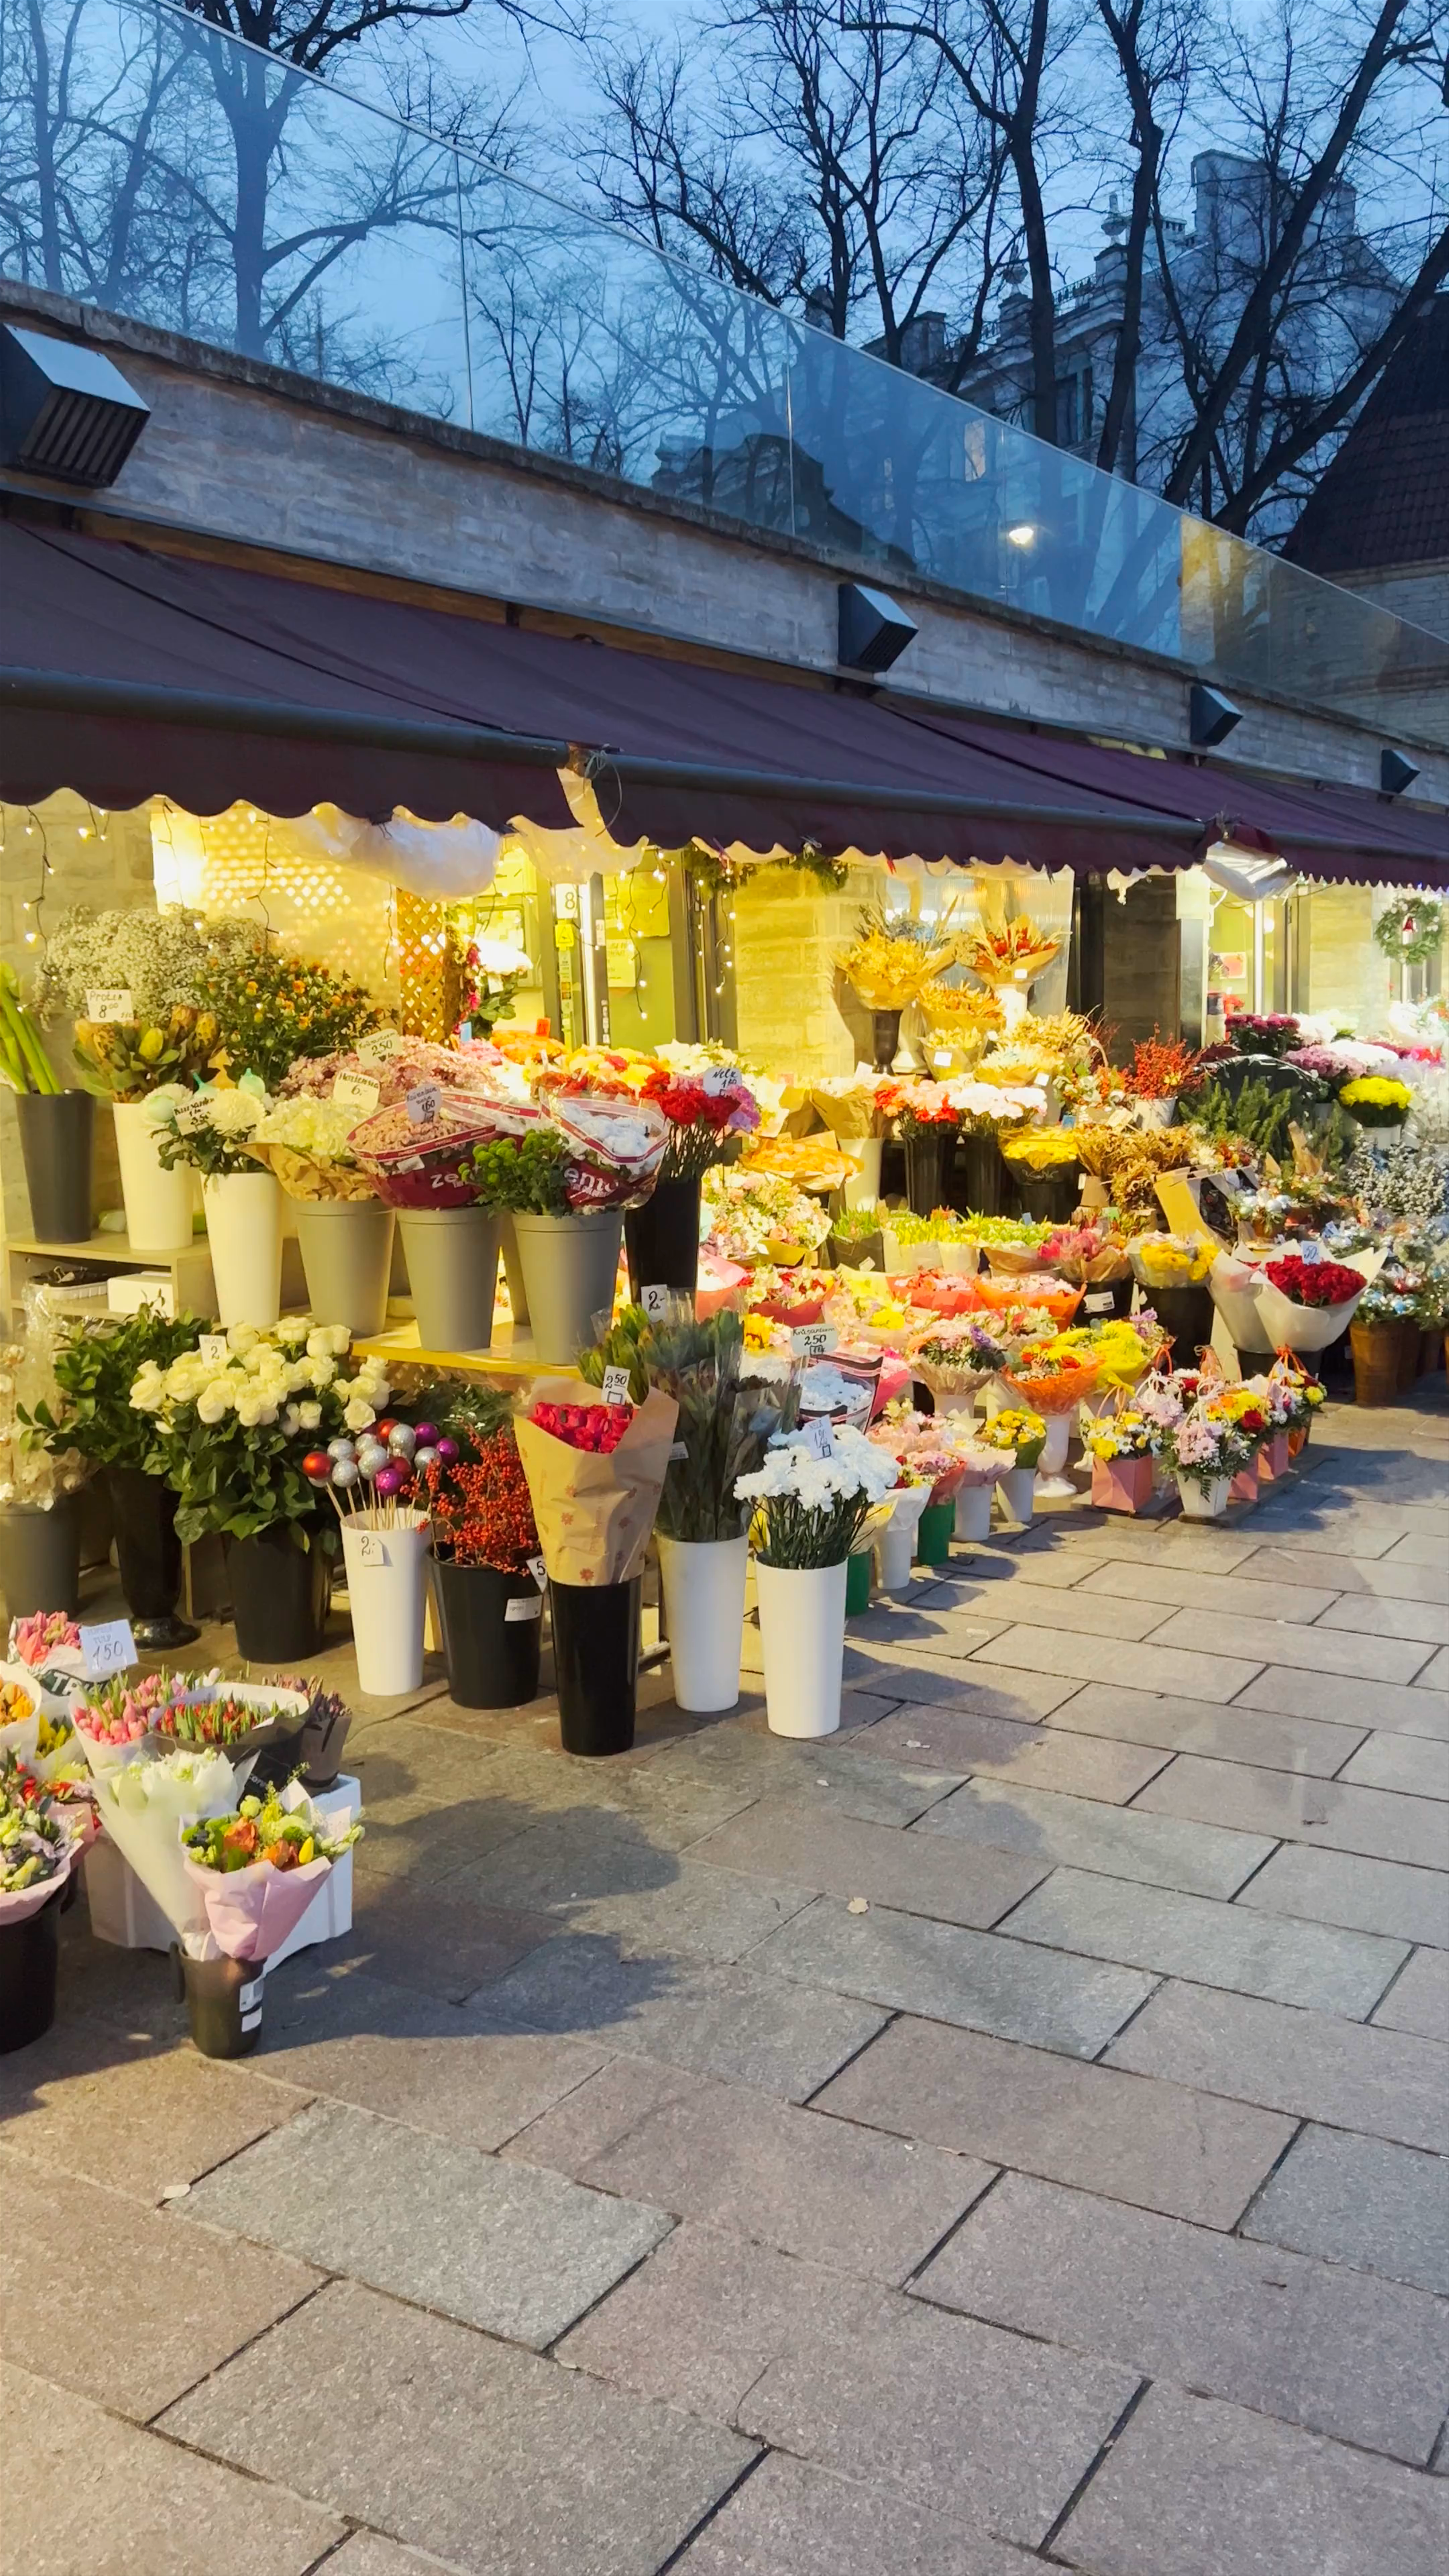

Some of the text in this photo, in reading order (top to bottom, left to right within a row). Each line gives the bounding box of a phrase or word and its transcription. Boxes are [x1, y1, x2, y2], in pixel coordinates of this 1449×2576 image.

[565, 892, 575, 910] 8
[804, 1335, 826, 1346] 250
[211, 1346, 220, 1360] 2
